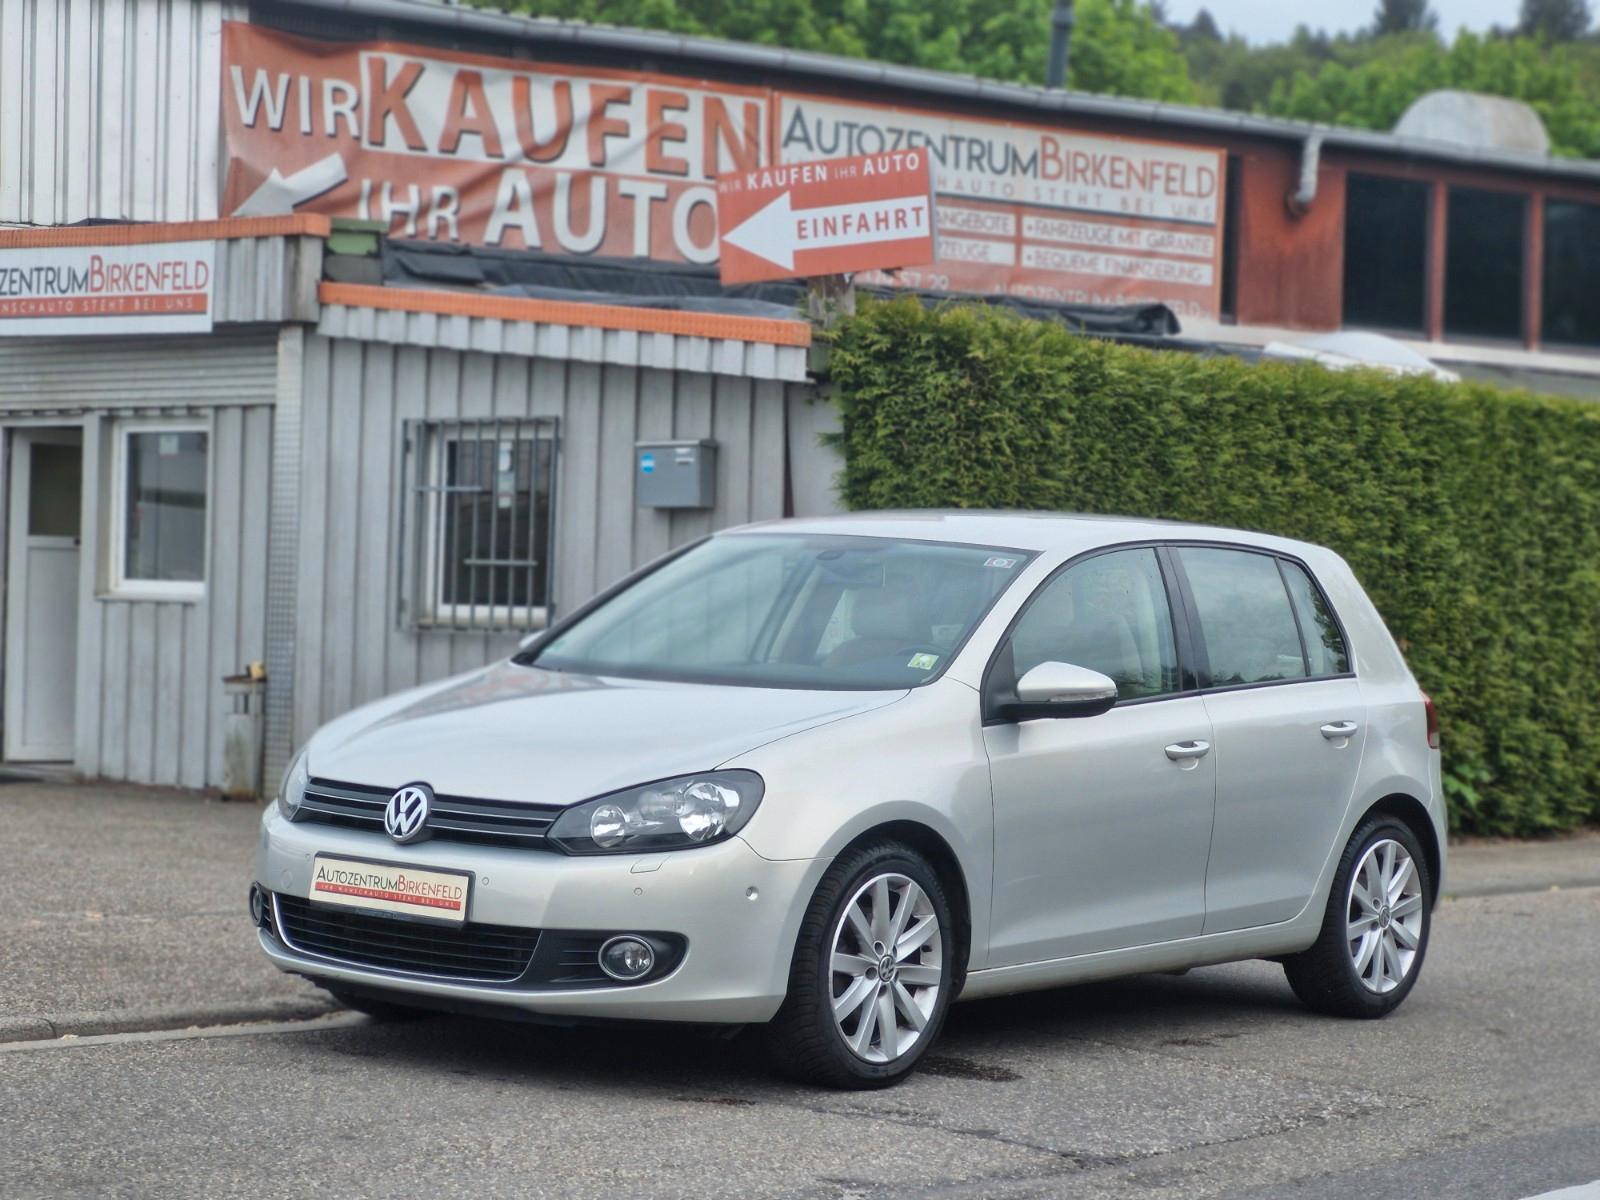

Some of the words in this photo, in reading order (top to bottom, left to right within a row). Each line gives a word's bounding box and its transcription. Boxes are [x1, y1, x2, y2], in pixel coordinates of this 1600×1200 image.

[230, 65, 361, 140] WIR
[366, 56, 759, 180] KAUFEN
[747, 165, 828, 190] KAUFEN
[834, 165, 857, 179] IHR
[863, 153, 919, 176] AUTO
[358, 179, 461, 240] IHR
[482, 168, 719, 265] AUTO
[797, 206, 924, 241] EINFAHRT
